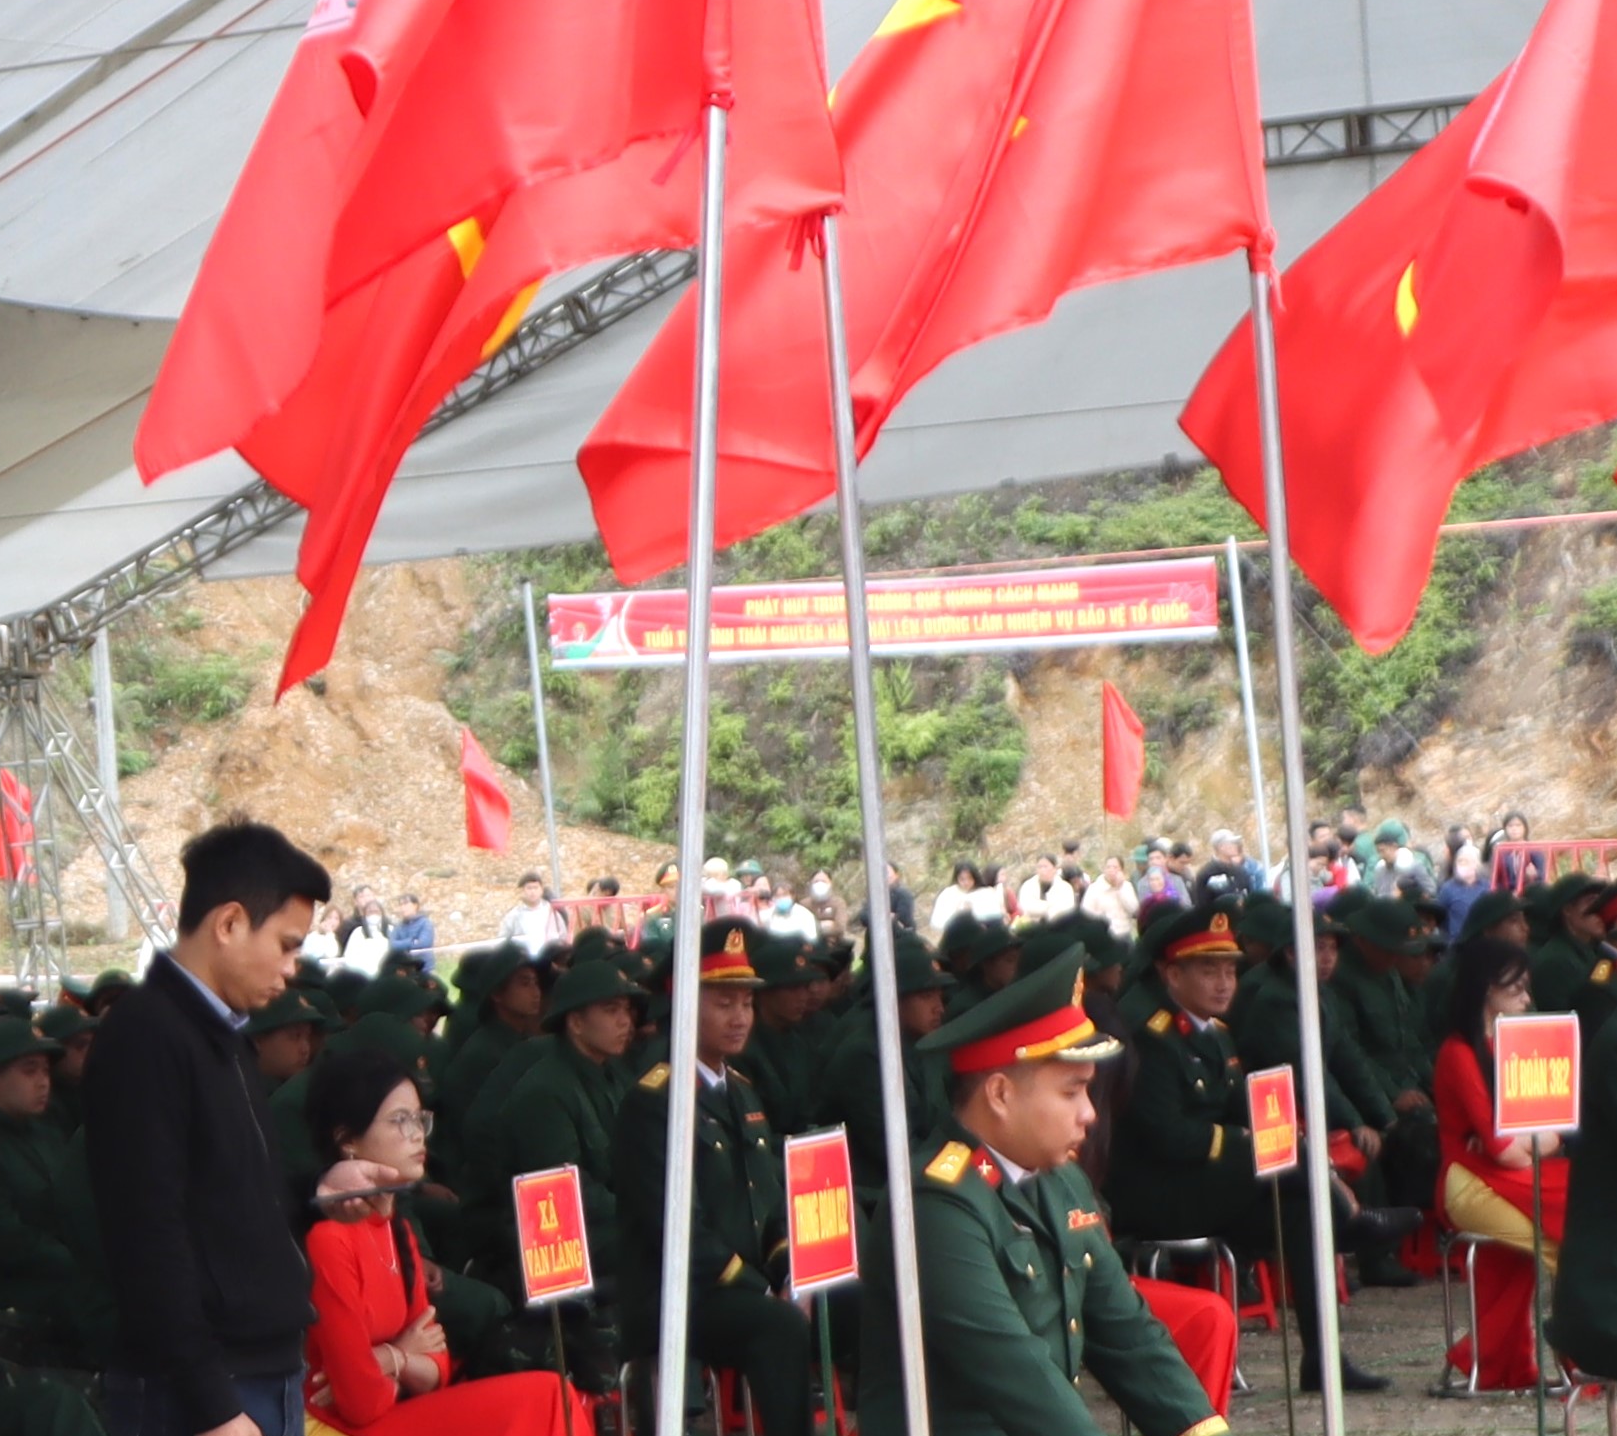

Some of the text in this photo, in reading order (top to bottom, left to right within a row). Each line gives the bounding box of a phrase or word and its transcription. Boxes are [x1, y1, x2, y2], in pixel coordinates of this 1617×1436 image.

[745, 594, 779, 616] PHÁT
[996, 581, 1033, 604] CÁCH
[1549, 1056, 1570, 1096] 382
